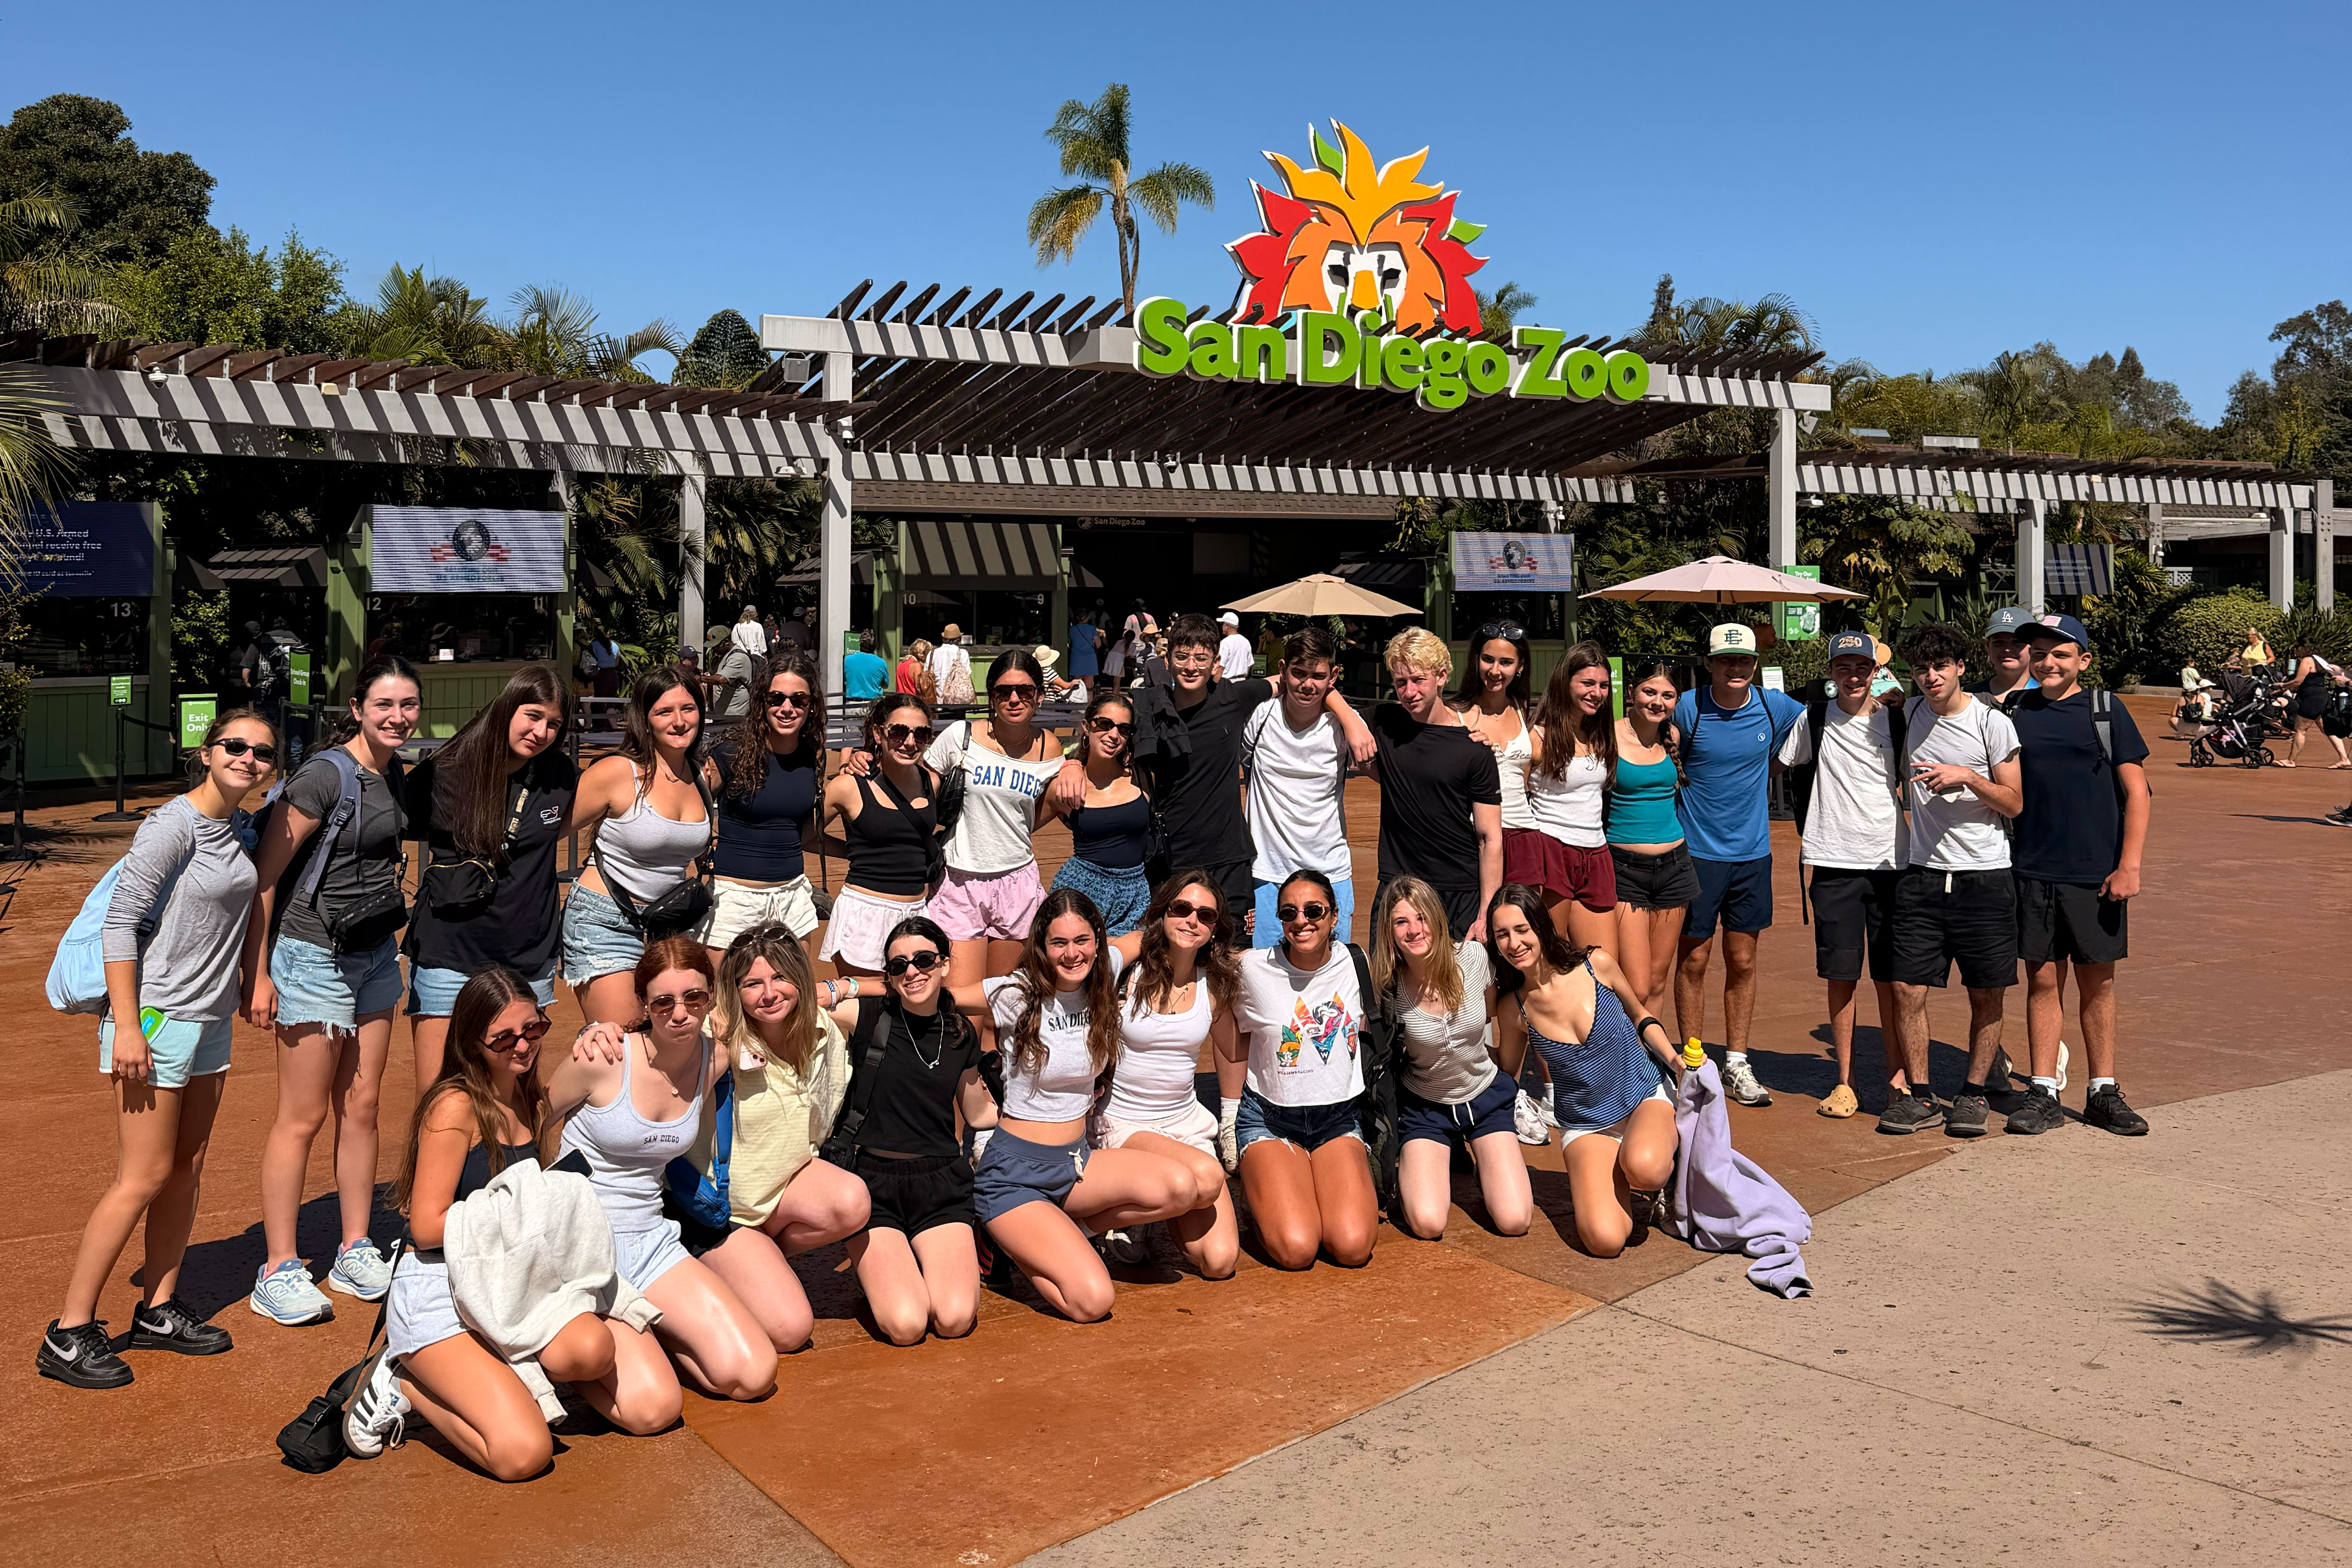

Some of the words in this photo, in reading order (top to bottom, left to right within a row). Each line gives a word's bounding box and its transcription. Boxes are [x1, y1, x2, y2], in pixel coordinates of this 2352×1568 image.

[1134, 296, 1286, 384] San
[1297, 309, 1510, 413] Diego
[1511, 326, 1650, 405] Zoo
[1109, 517, 1130, 527] Diego
[366, 597, 382, 611] 12
[903, 593, 916, 604] 10
[1037, 593, 1044, 604] 9
[111, 602, 131, 617] 13
[2061, 602, 2065, 610] 5
[2002, 611, 2013, 623] LA
[188, 713, 209, 722] Exit
[973, 765, 1005, 787] SAN
[1009, 769, 1042, 799] DIEG
[1048, 1014, 1068, 1032] SAN
[1069, 1010, 1091, 1027] DIEG
[643, 1135, 658, 1144] SAN
[660, 1135, 679, 1144] DIEGO
